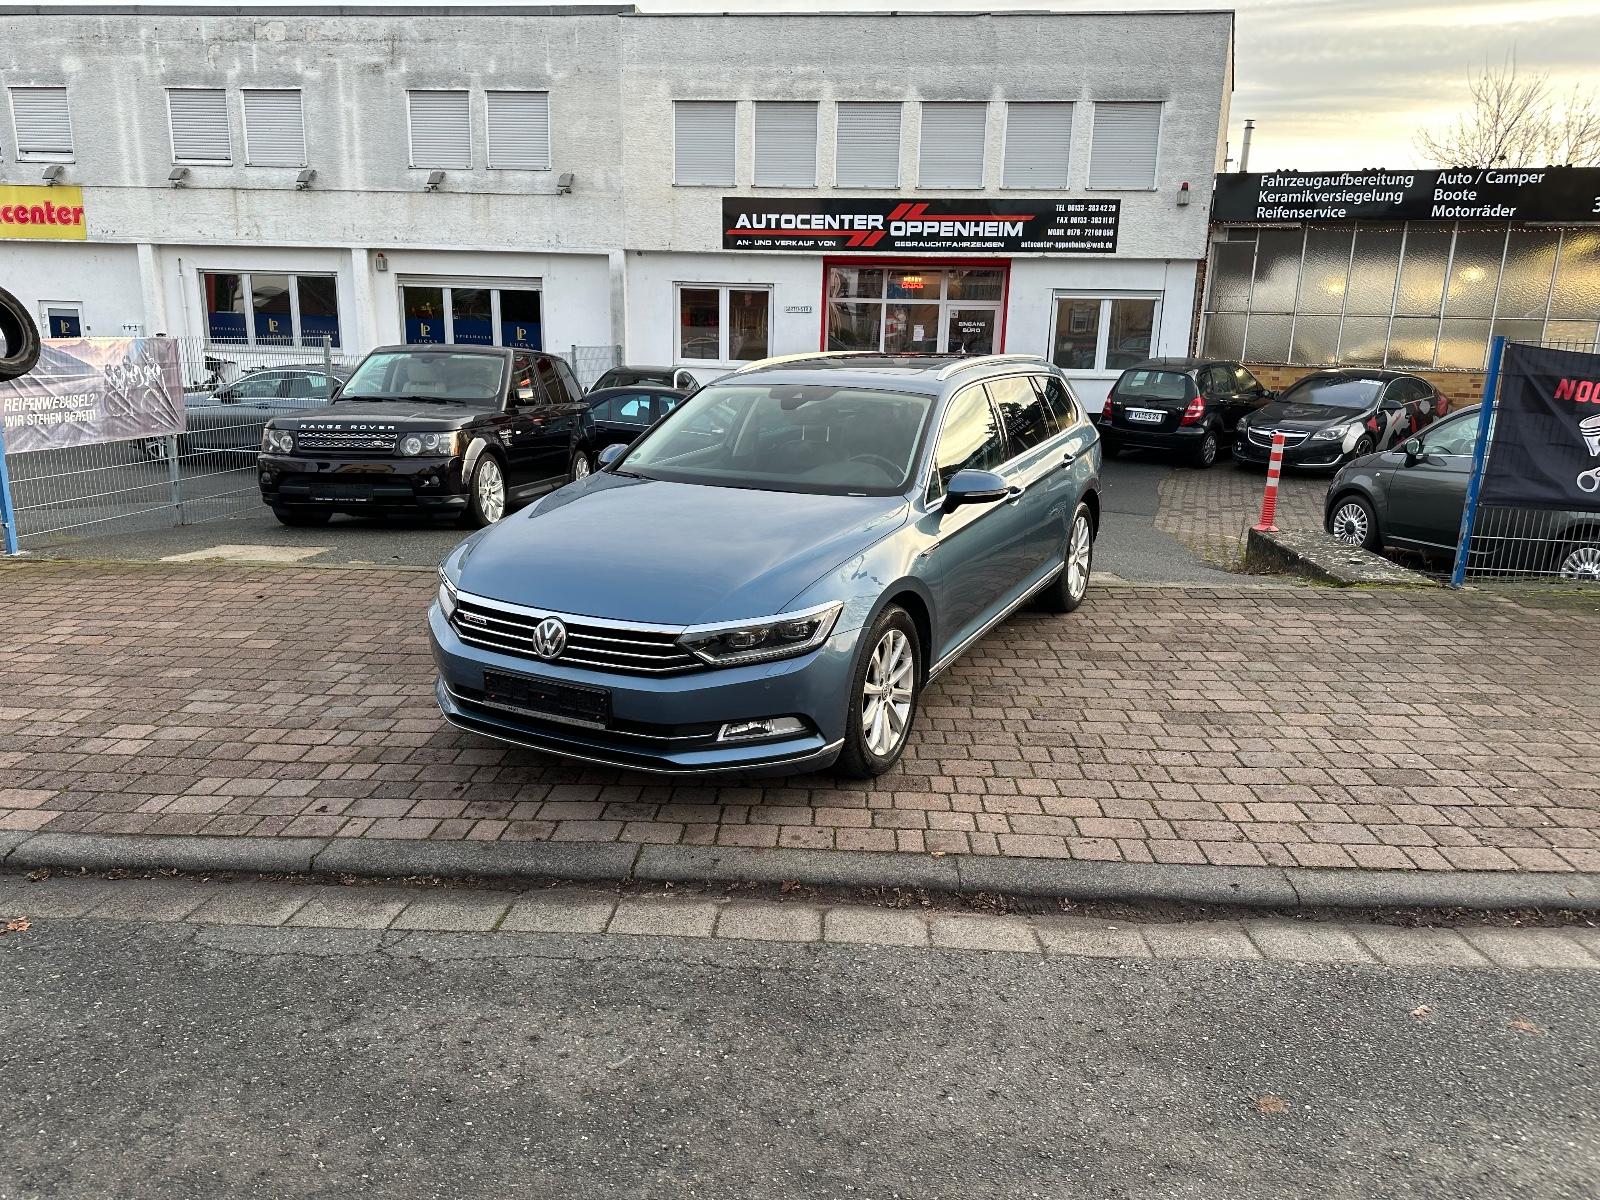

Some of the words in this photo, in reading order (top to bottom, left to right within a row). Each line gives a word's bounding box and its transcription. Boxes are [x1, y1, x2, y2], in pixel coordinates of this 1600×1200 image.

[1260, 173, 1414, 188] Fahrzeugaufbereitung
[1436, 172, 1472, 184] Auto
[1486, 172, 1546, 186] Camper
[1258, 190, 1404, 204] Keramikversiegelung
[1434, 188, 1477, 200] Boote
[0, 201, 84, 225] center
[1256, 206, 1346, 218] Reifenservice
[1431, 204, 1516, 217] Motorräder
[734, 214, 884, 230] AUTOCENTER
[890, 221, 1024, 237] OPPENHEIM
[4, 393, 95, 412] REIFENWECHSEL?
[4, 414, 24, 428] WIR
[27, 412, 62, 426] STEHEN
